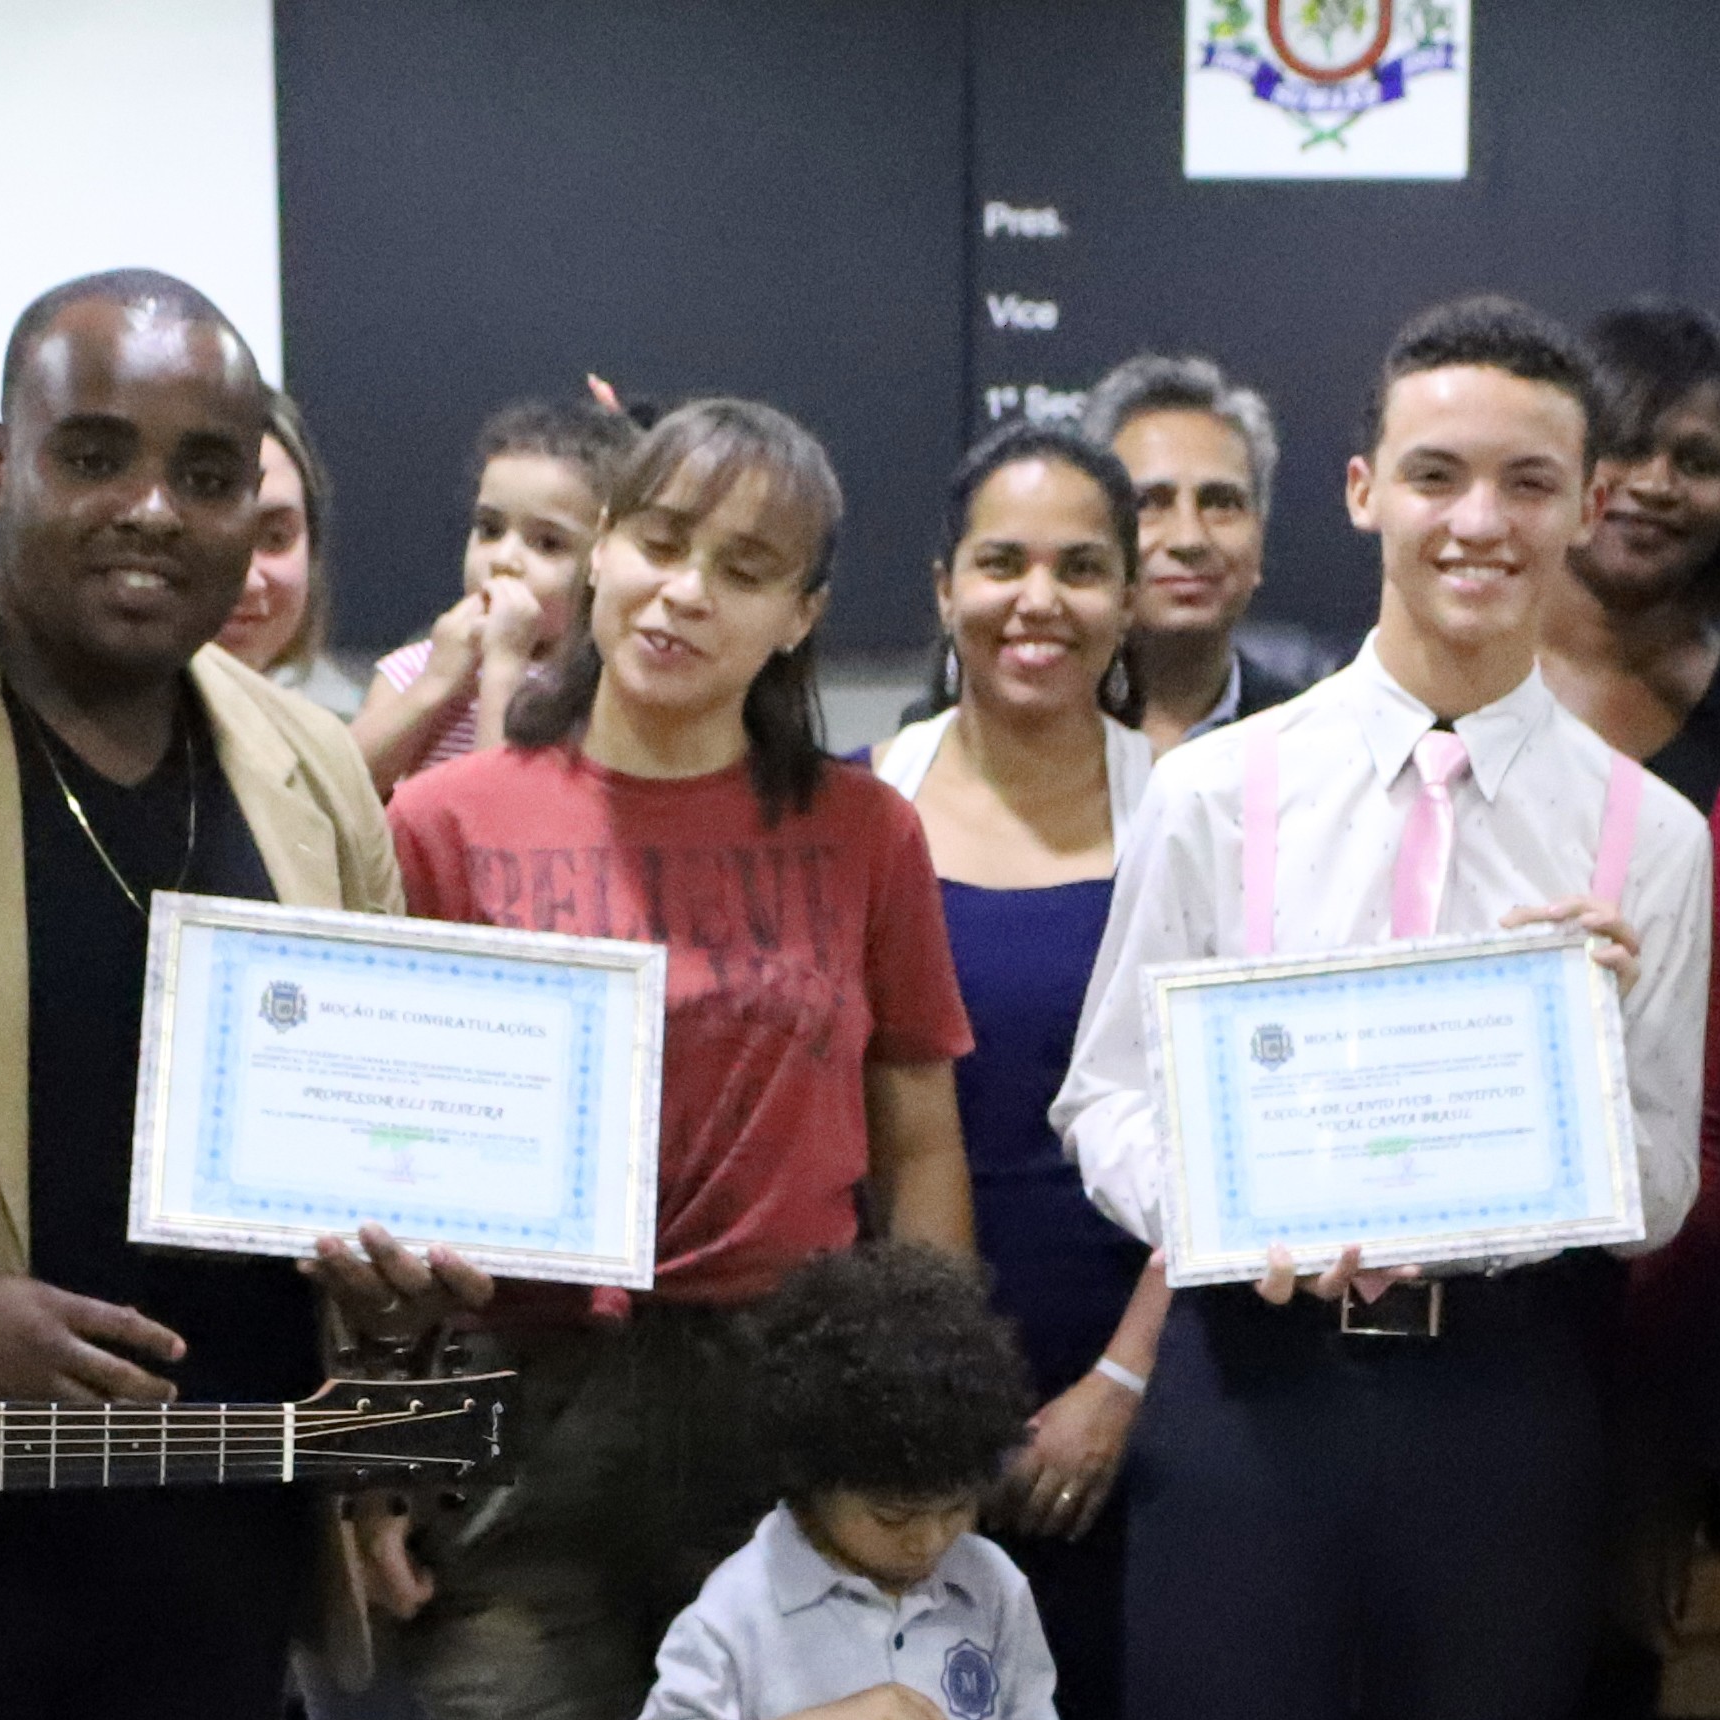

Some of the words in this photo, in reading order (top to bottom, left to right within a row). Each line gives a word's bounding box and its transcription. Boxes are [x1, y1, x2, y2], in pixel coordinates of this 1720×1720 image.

[987, 294, 1058, 331] Vice
[319, 1001, 374, 1020] MOÇÃO
[378, 1009, 398, 1021] DE
[401, 1011, 548, 1038] CONGRATULAÇÕES
[1357, 1027, 1377, 1041] DE
[1379, 1014, 1515, 1038] CONGRATULAÇÕES
